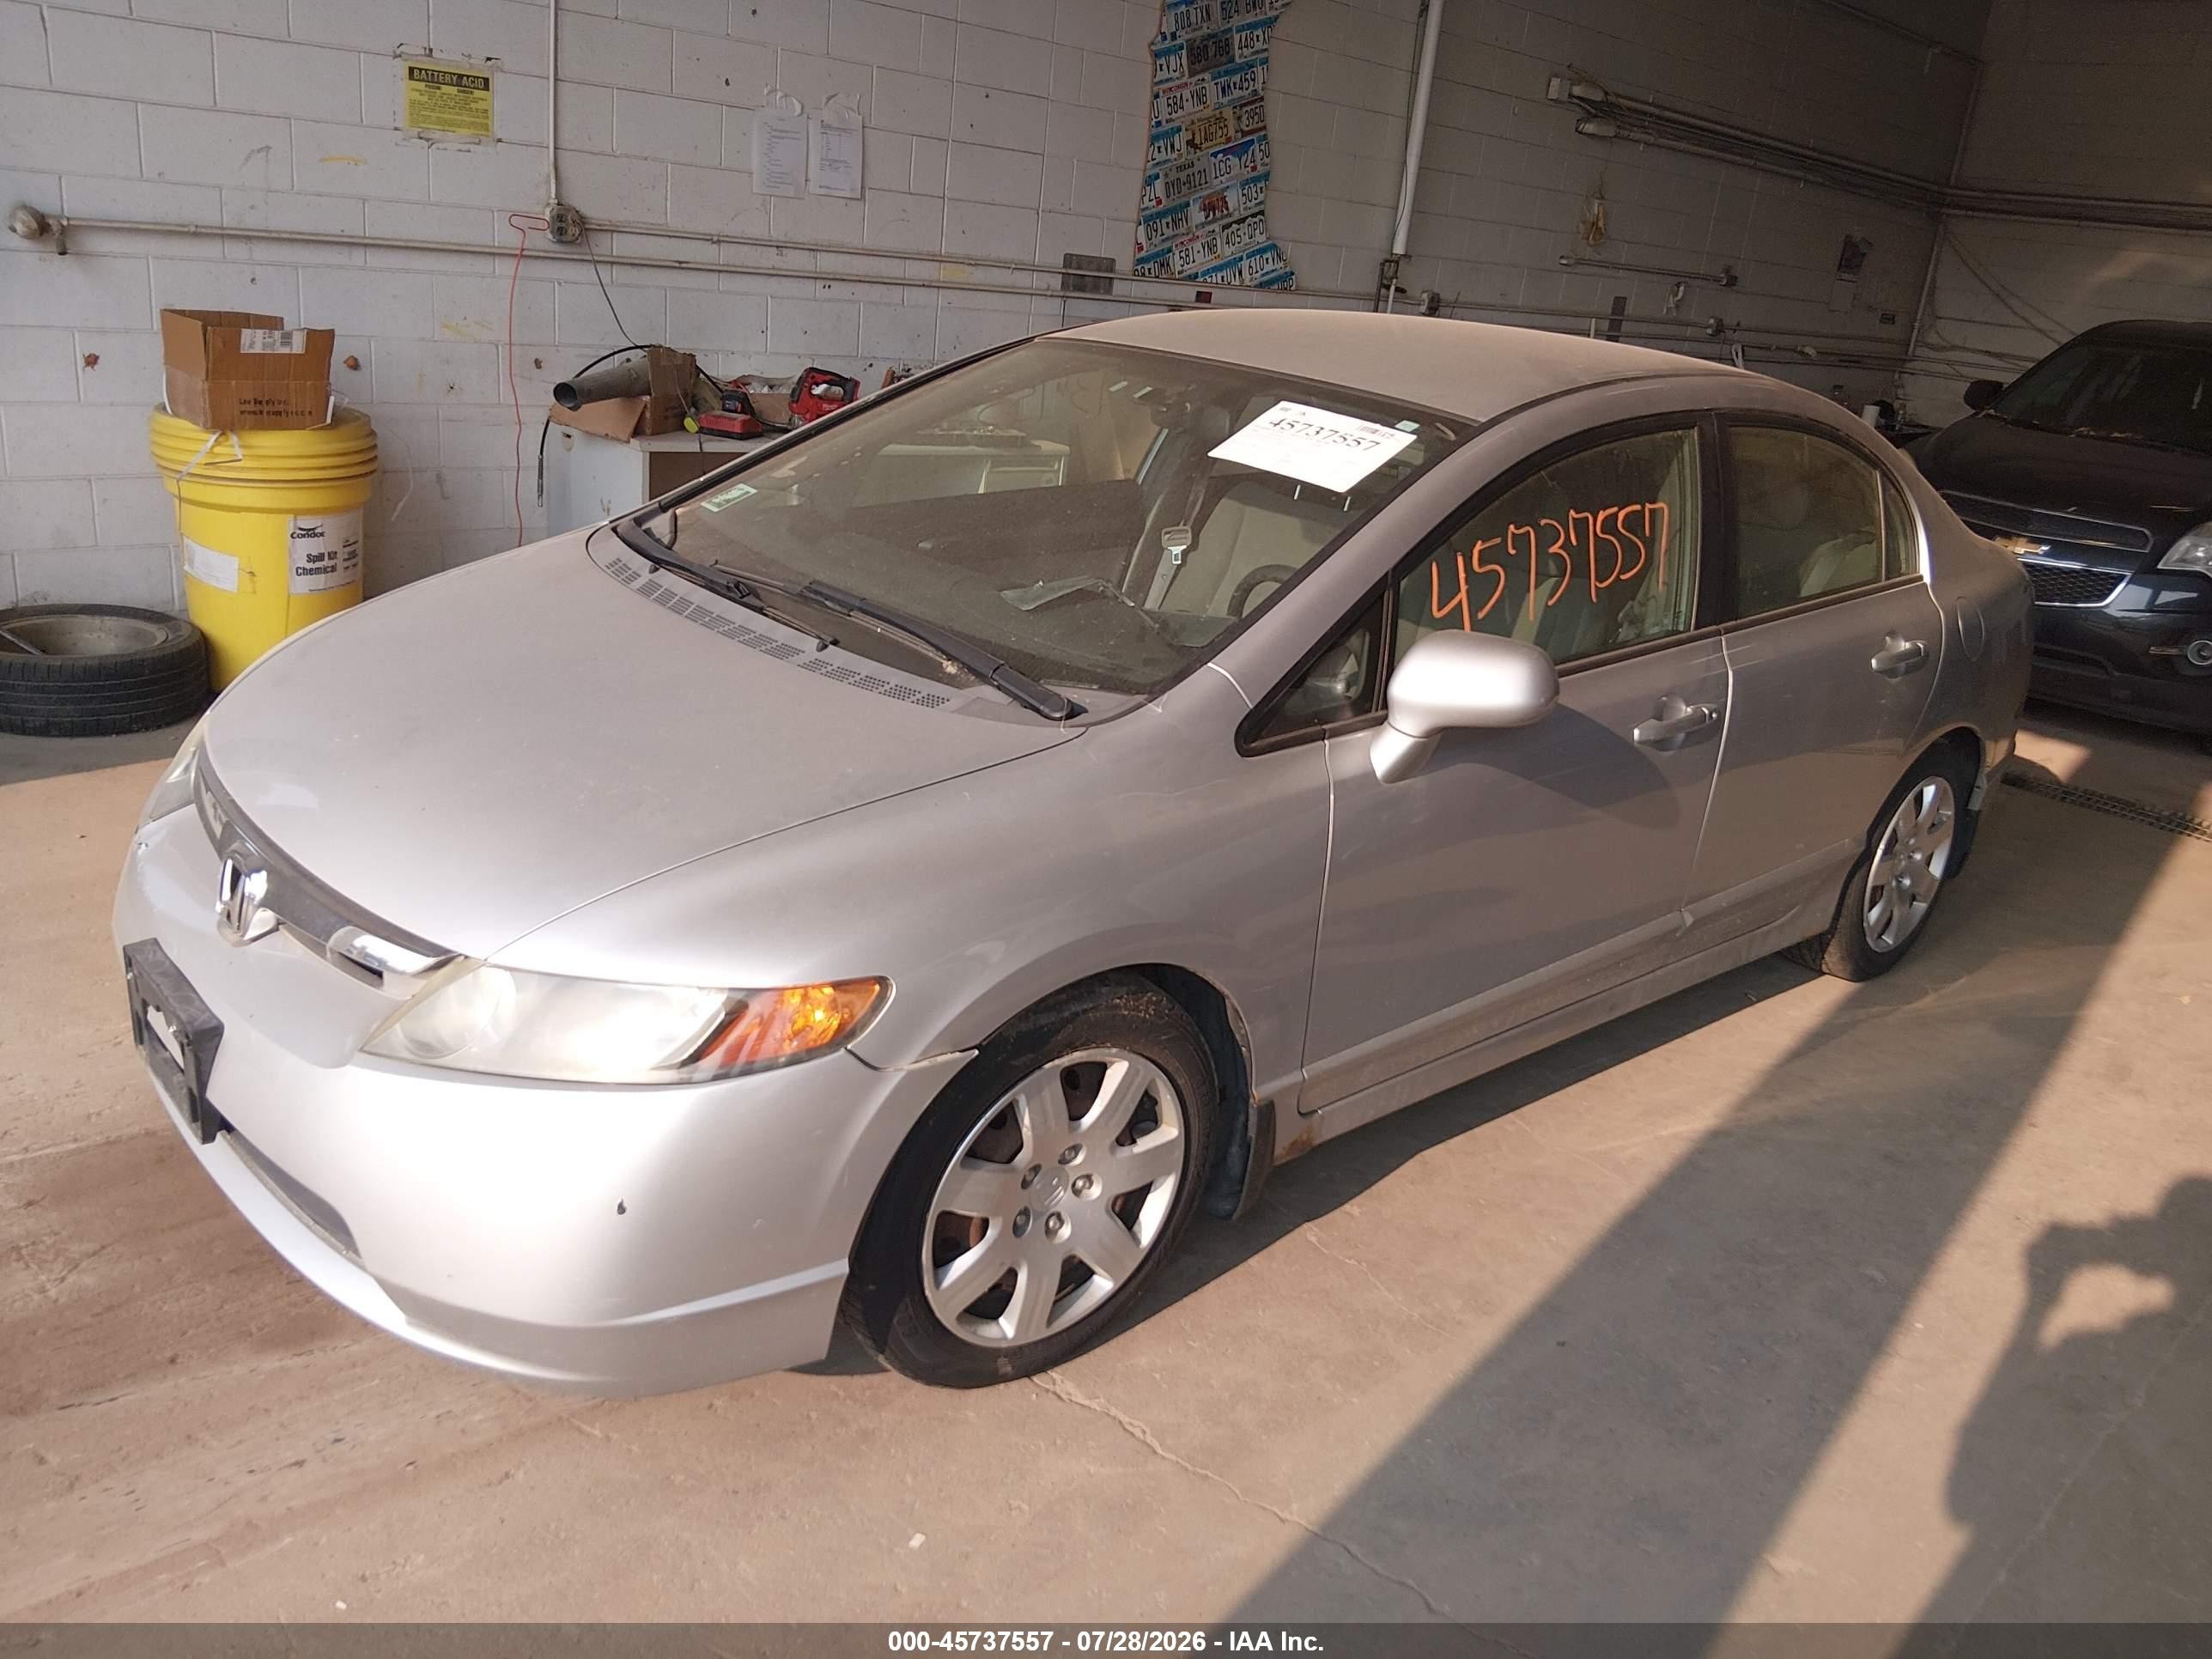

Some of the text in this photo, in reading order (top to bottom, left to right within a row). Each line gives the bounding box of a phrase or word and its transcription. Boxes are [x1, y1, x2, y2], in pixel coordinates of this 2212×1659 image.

[1174, 9, 1192, 32] 808
[1194, 3, 1211, 26] TXN
[1237, 30, 1255, 52] 448
[413, 68, 485, 89] BATTERY ACID
[1237, 69, 1256, 93] 459
[1166, 86, 1207, 116] 584-YNB
[1176, 161, 1194, 173] TEXAS
[1241, 183, 1259, 205] 503
[1146, 218, 1165, 242] 091
[1178, 237, 1218, 268] 581-YNB
[1248, 255, 1265, 276] 610
[1268, 417, 1382, 452] 45737557
[289, 531, 326, 539] Condor
[306, 550, 337, 564] Spill Kit
[1432, 501, 1668, 632] 45737557
[295, 562, 337, 577] Chemical
